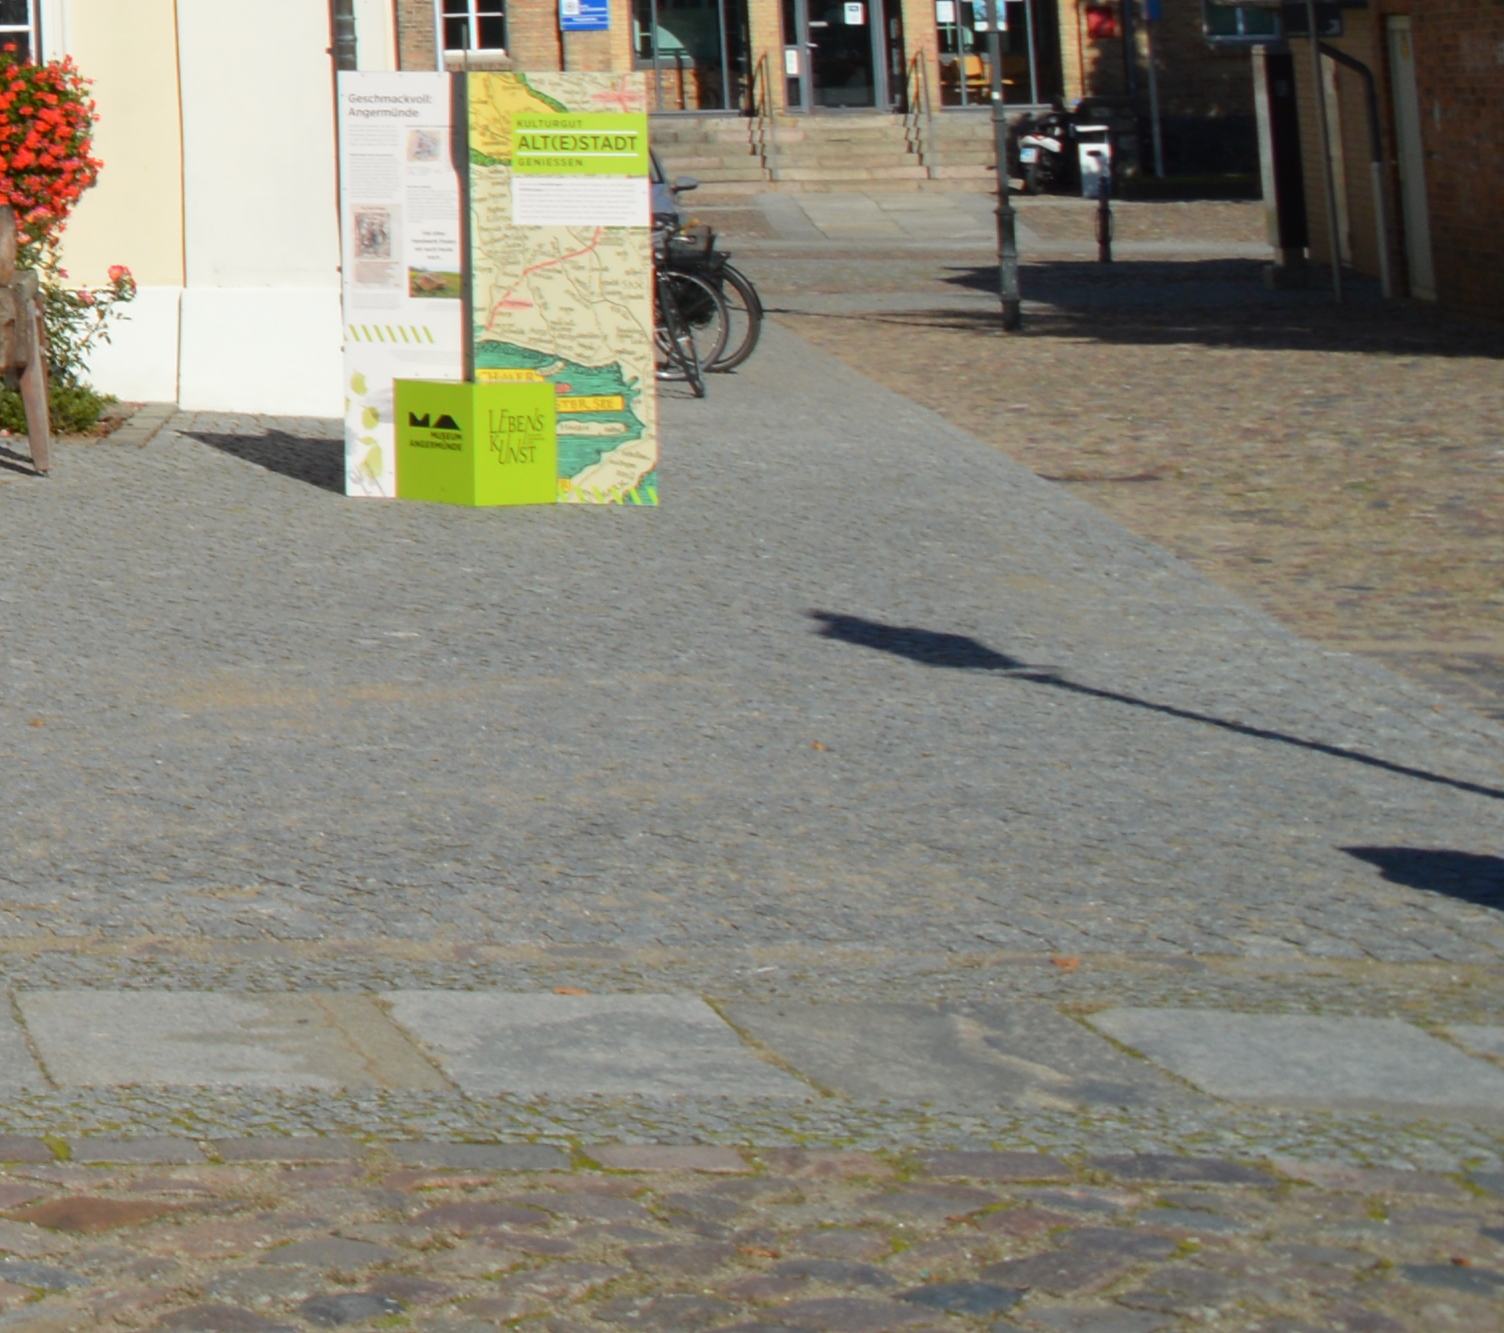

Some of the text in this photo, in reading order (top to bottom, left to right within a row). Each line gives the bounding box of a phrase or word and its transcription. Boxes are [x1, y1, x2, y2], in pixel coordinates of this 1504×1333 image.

[348, 107, 419, 118] Angermünde
[516, 119, 583, 128] KULTURGUT
[517, 135, 638, 151] ALT(E)STADT
[517, 157, 583, 167] GENIESSEN
[488, 407, 545, 434] LEBENS
[430, 431, 463, 440] MUSEUM
[409, 439, 463, 451] ANGERMÜNDE
[489, 434, 537, 465] KUNST
